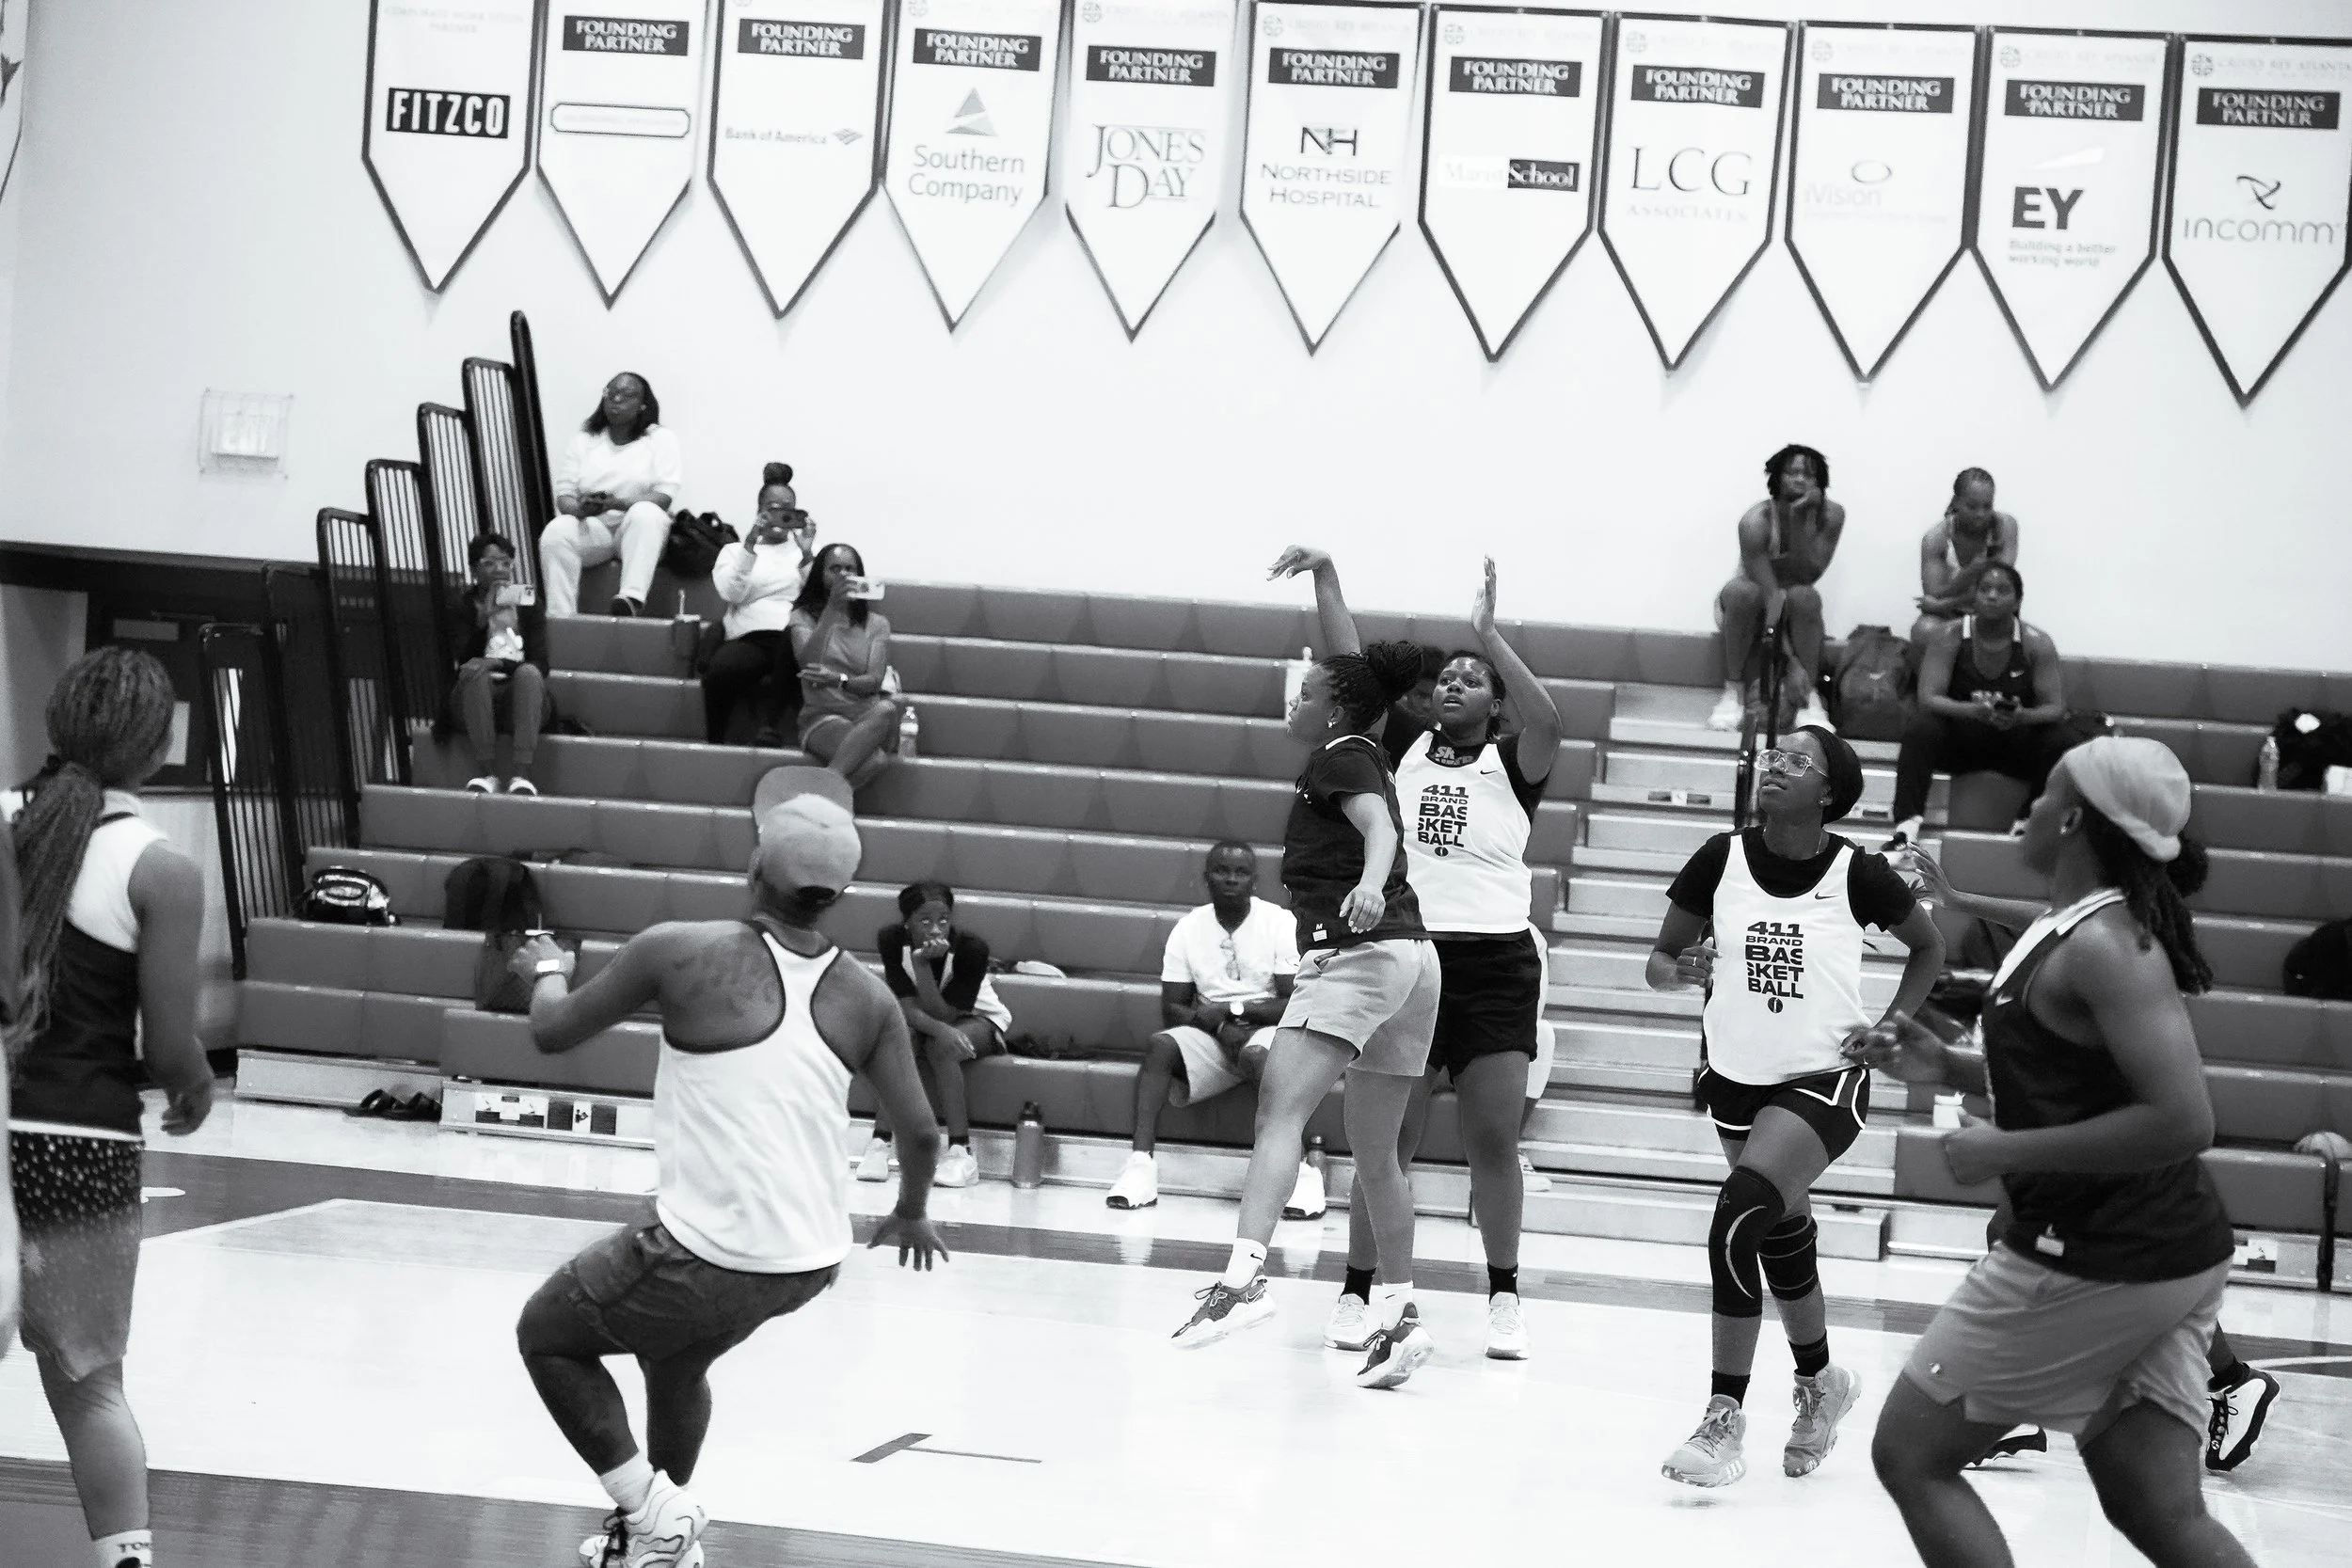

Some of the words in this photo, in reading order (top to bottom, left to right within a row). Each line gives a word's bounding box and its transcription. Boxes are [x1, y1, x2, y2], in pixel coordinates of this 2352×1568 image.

[576, 20, 677, 40] FOUNDING
[752, 22, 853, 43] FOUNDING
[584, 34, 666, 53] PARTNER
[759, 39, 842, 58] PARTNER
[927, 33, 1029, 55] FOUNDING
[934, 48, 1017, 68] PARTNER
[1100, 50, 1204, 71] FOUNDING
[1282, 53, 1388, 73] FOUNDING
[1108, 65, 1193, 85] PARTNER
[1291, 68, 1375, 87] PARTNER
[1463, 60, 1569, 81] FOUNDING
[1645, 69, 1753, 91] FOUNDING
[1471, 75, 1557, 95] PARTNER
[1654, 85, 1740, 104] PARTNER
[1831, 77, 1942, 98] FOUNDING
[2019, 84, 2131, 105] FOUNDING
[1840, 92, 1930, 111] PARTNER
[2026, 101, 2119, 119] PARTNER
[2212, 91, 2325, 112] FOUNDING
[392, 90, 504, 136] FITZCO
[2222, 108, 2312, 127] PARTNER
[725, 126, 755, 139] Bank
[759, 128, 772, 141] of
[774, 130, 827, 145] America
[913, 145, 1025, 174] Southern
[1085, 122, 1206, 179] JONES
[1260, 163, 1392, 186] NORTHSIDE
[1509, 162, 1575, 188] School
[1629, 146, 1754, 197] LCG
[908, 174, 1024, 206] Company
[1105, 163, 1196, 209] DAY
[1269, 187, 1380, 209] HOSPITAL
[2011, 186, 2084, 230] EY
[2008, 239, 2061, 254] Building
[1421, 796, 1468, 805] BRAND
[1422, 784, 1469, 799] 411
[1418, 832, 1465, 847] BALL
[1747, 921, 1804, 939] 411
[1746, 936, 1803, 946] BRAND
[1748, 977, 1804, 999] BALL
